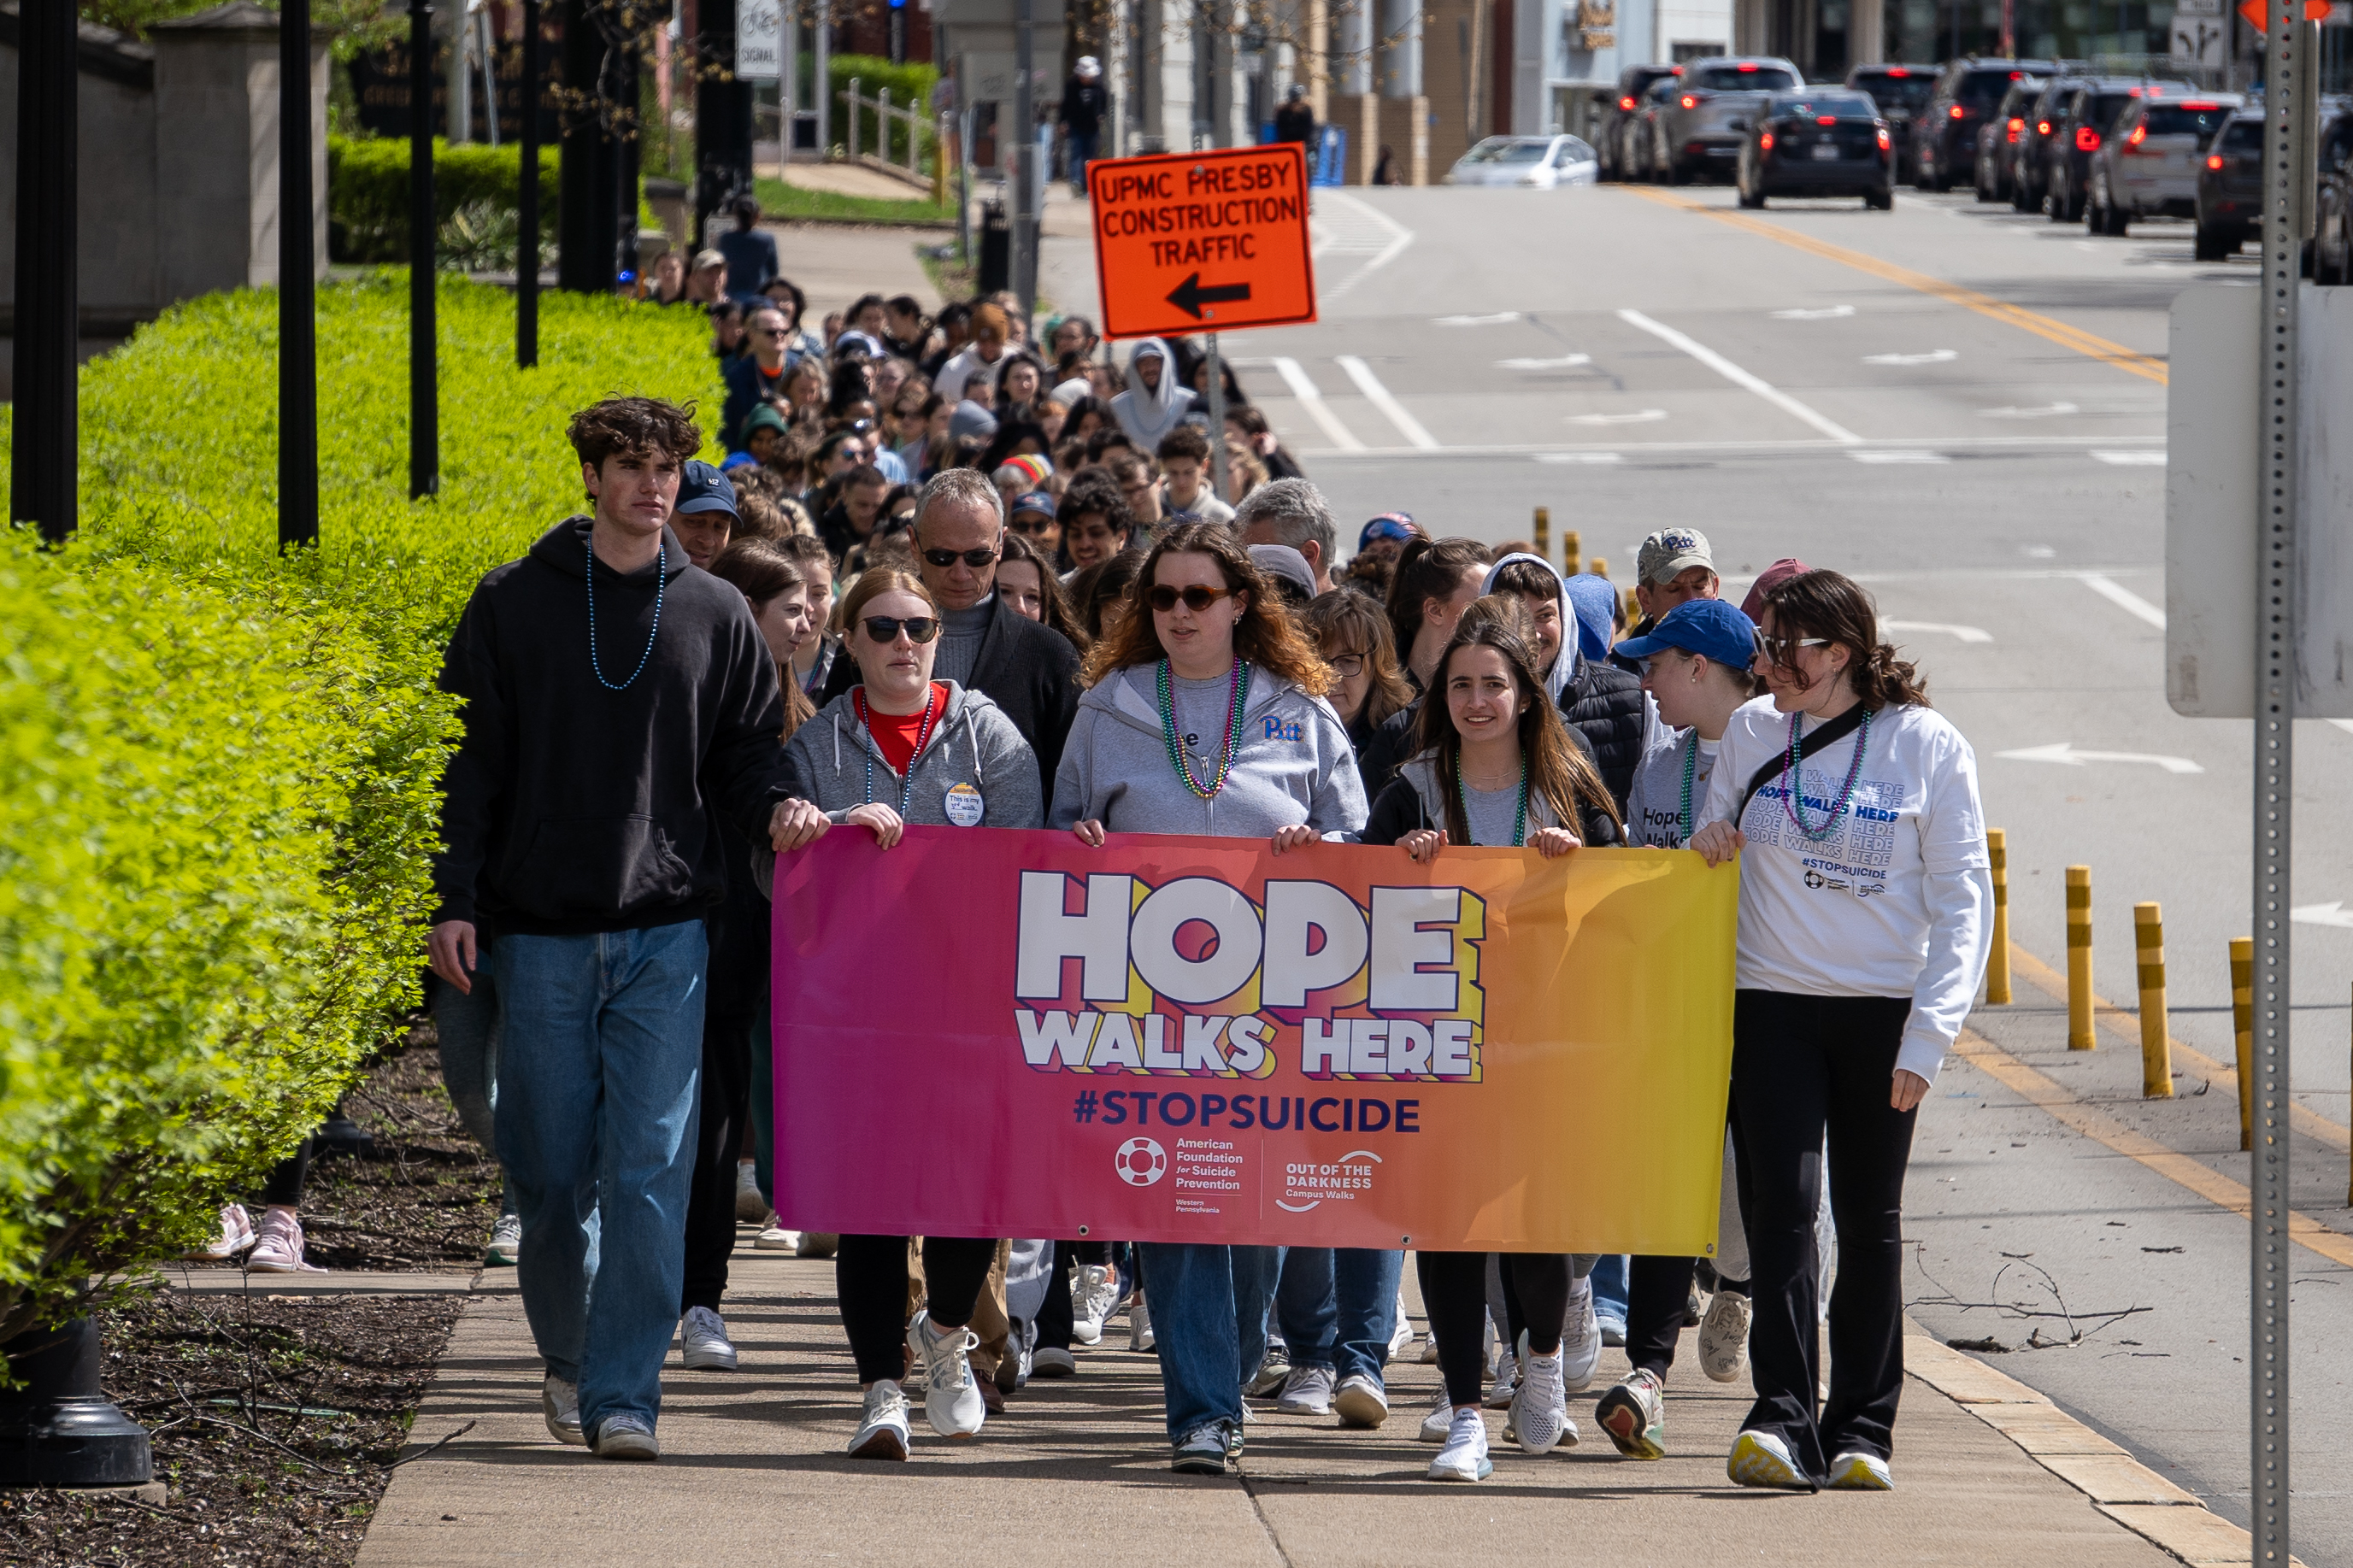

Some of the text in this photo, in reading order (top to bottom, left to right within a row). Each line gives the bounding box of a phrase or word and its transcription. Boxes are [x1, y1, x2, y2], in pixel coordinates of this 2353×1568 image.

[741, 46, 776, 63] SIGNAL
[1101, 161, 1291, 203] UPMC PRESBY
[1102, 195, 1297, 238] CONSTRUCTION
[1150, 232, 1256, 267] TRAFFIC
[1662, 535, 1696, 551] Pitt
[1257, 714, 1304, 742] Pitt
[1862, 779, 1905, 798] HERE
[1857, 792, 1903, 810] HERE
[1750, 797, 1785, 817] HOPE
[1852, 818, 1895, 837] HERE
[1855, 805, 1899, 823] HERE
[1745, 811, 1783, 831] HOPE
[1850, 833, 1894, 852] HERE
[1783, 835, 1843, 860] WALKS
[1847, 849, 1891, 866] HERE
[1802, 858, 1887, 879] #STOPSUICIDE
[1015, 869, 1465, 1012] HOPE
[1014, 1008, 1474, 1077] WALKS HERE
[1074, 1090, 1421, 1133] #STOPSUICIDE
[1176, 1137, 1233, 1150] American
[1176, 1151, 1243, 1164] Foundation
[1176, 1165, 1236, 1177] for Suicide
[1286, 1163, 1372, 1176] OUT OF THE
[1176, 1177, 1240, 1190] Prevention
[1286, 1175, 1372, 1189] DARKNESS
[1175, 1198, 1204, 1207] Western
[1285, 1189, 1355, 1200] Campus Walks
